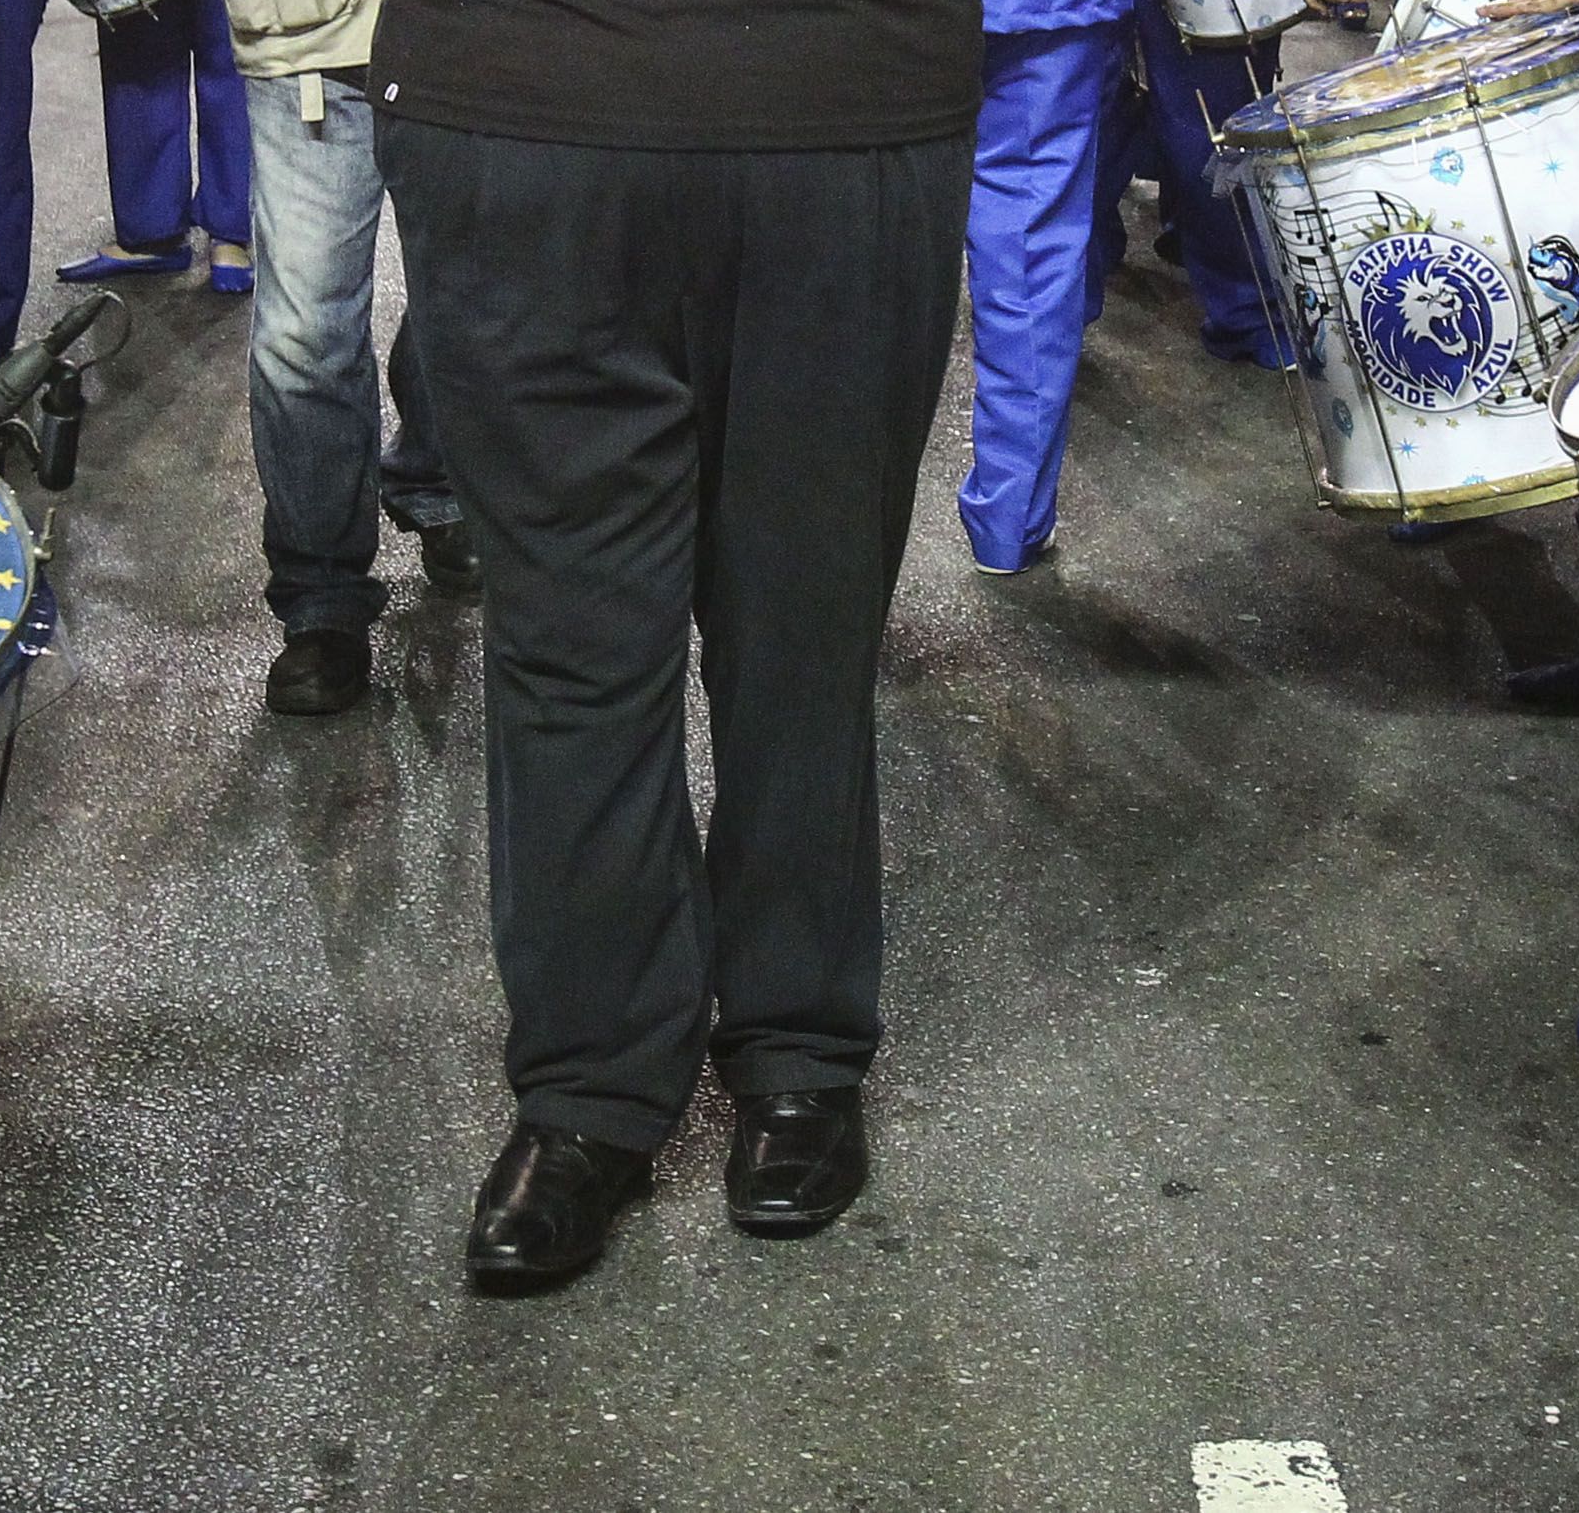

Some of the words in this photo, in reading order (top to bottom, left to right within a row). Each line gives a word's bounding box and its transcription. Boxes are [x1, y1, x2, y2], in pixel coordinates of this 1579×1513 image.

[1349, 237, 1433, 287] BATERIA
[1447, 245, 1510, 303] SHOW
[1345, 319, 1436, 408] MOCIDADE
[1471, 338, 1514, 393] AZUL
